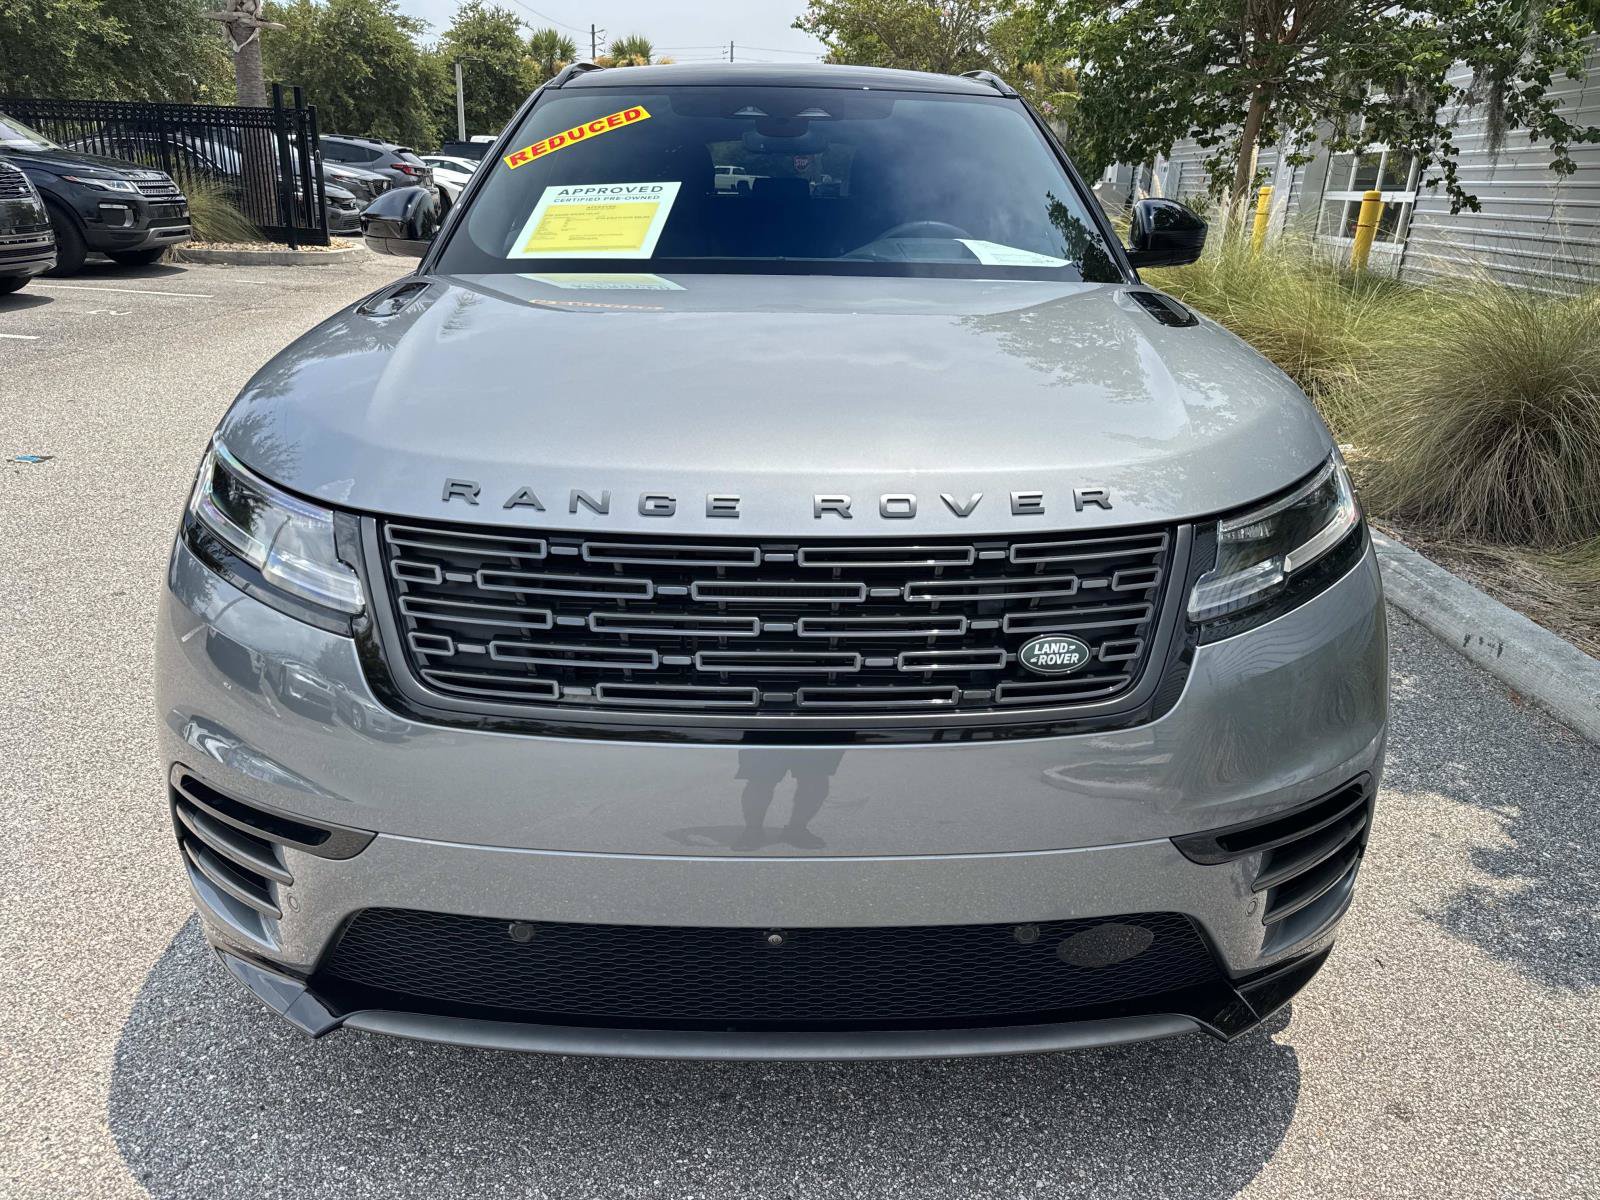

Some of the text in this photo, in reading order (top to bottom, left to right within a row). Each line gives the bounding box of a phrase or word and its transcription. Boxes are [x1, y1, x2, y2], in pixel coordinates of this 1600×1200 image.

[509, 108, 641, 167] REDUCED
[558, 185, 664, 196] APPROVED
[441, 477, 1113, 519] RANGE ROVER
[1034, 642, 1068, 654] LAND
[1038, 653, 1079, 665] ROVER
